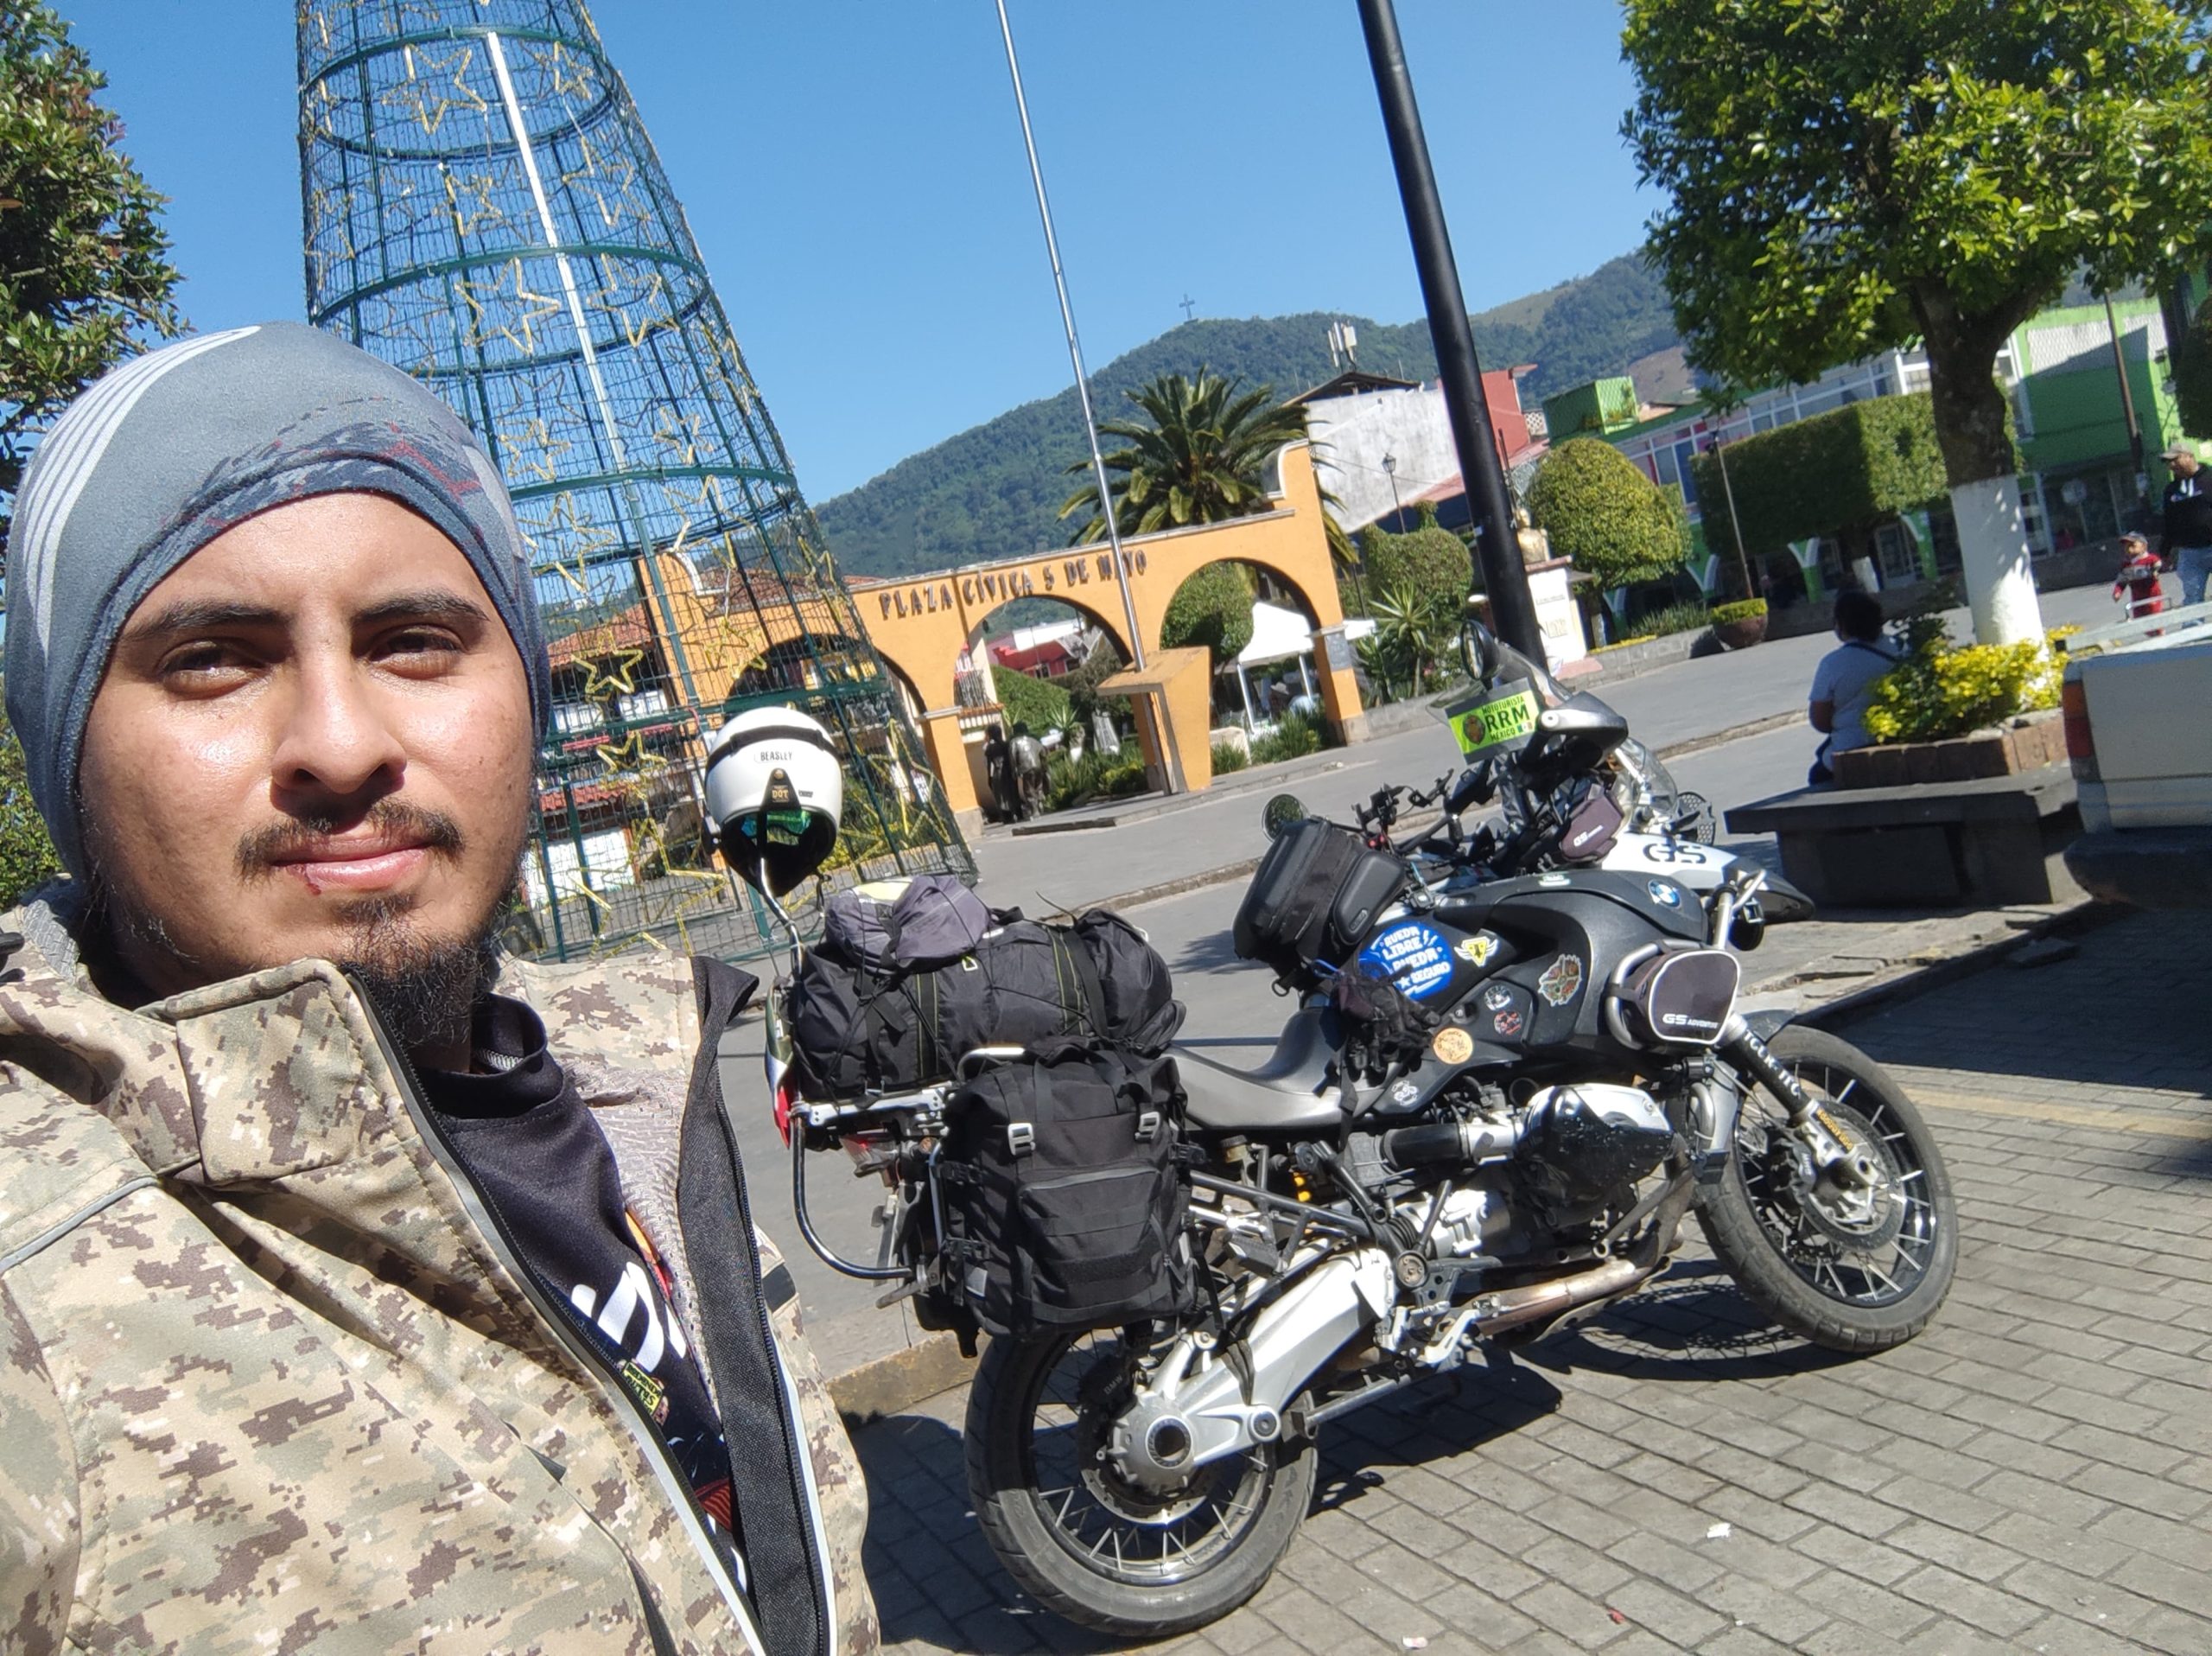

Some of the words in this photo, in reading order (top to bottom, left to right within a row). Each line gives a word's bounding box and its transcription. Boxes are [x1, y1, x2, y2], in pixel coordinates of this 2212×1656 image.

[880, 583, 952, 620] PLAZA
[1065, 557, 1089, 587] DE
[1096, 550, 1147, 581] MYO
[1481, 695, 1525, 715] MOTOTURISTA
[1484, 704, 1530, 733] RRM
[772, 789, 789, 799] DOT
[1643, 843, 1707, 864] GS
[1383, 926, 1420, 947] RUEDA
[1382, 936, 1423, 960] LIBRE
[1410, 961, 1451, 984] SEGURO
[1662, 1013, 1688, 1025] GS
